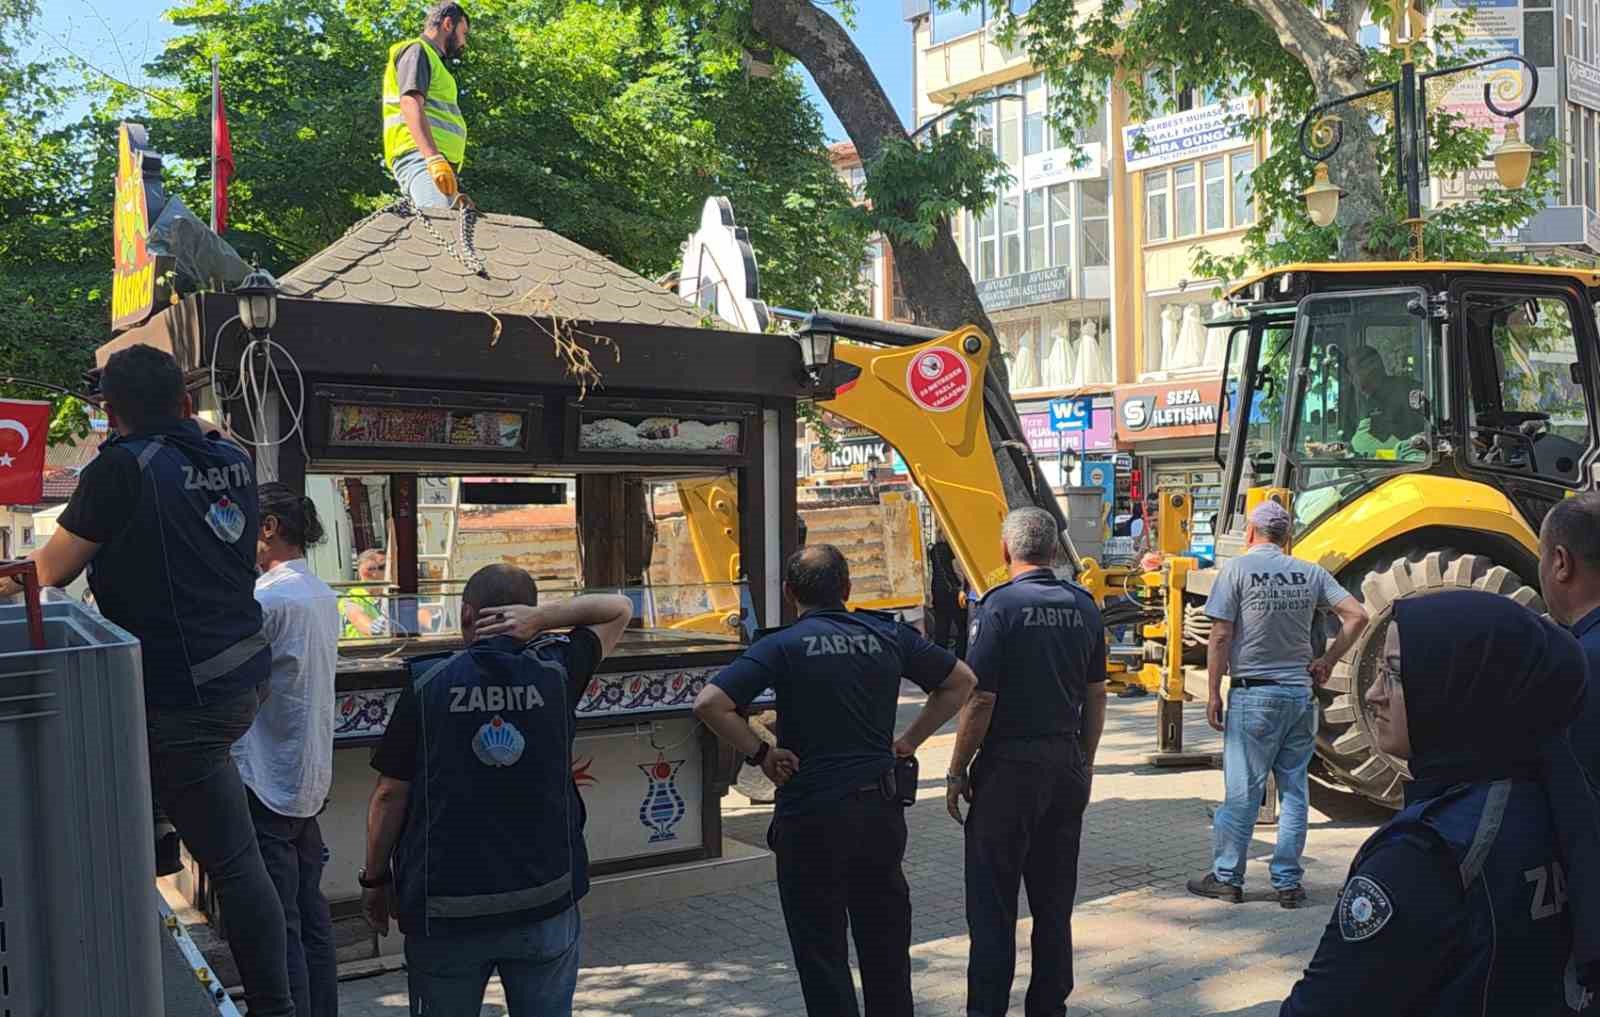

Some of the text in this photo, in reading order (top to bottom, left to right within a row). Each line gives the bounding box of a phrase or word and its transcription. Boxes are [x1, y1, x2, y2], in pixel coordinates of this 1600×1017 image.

[1167, 388, 1201, 405] SEFA
[1051, 401, 1086, 418] WC
[181, 462, 252, 491] ZABITA
[1249, 571, 1307, 586] MAB
[1021, 606, 1084, 628] ZABITA
[802, 632, 883, 656] ZABITA
[449, 684, 545, 712] ZABITA
